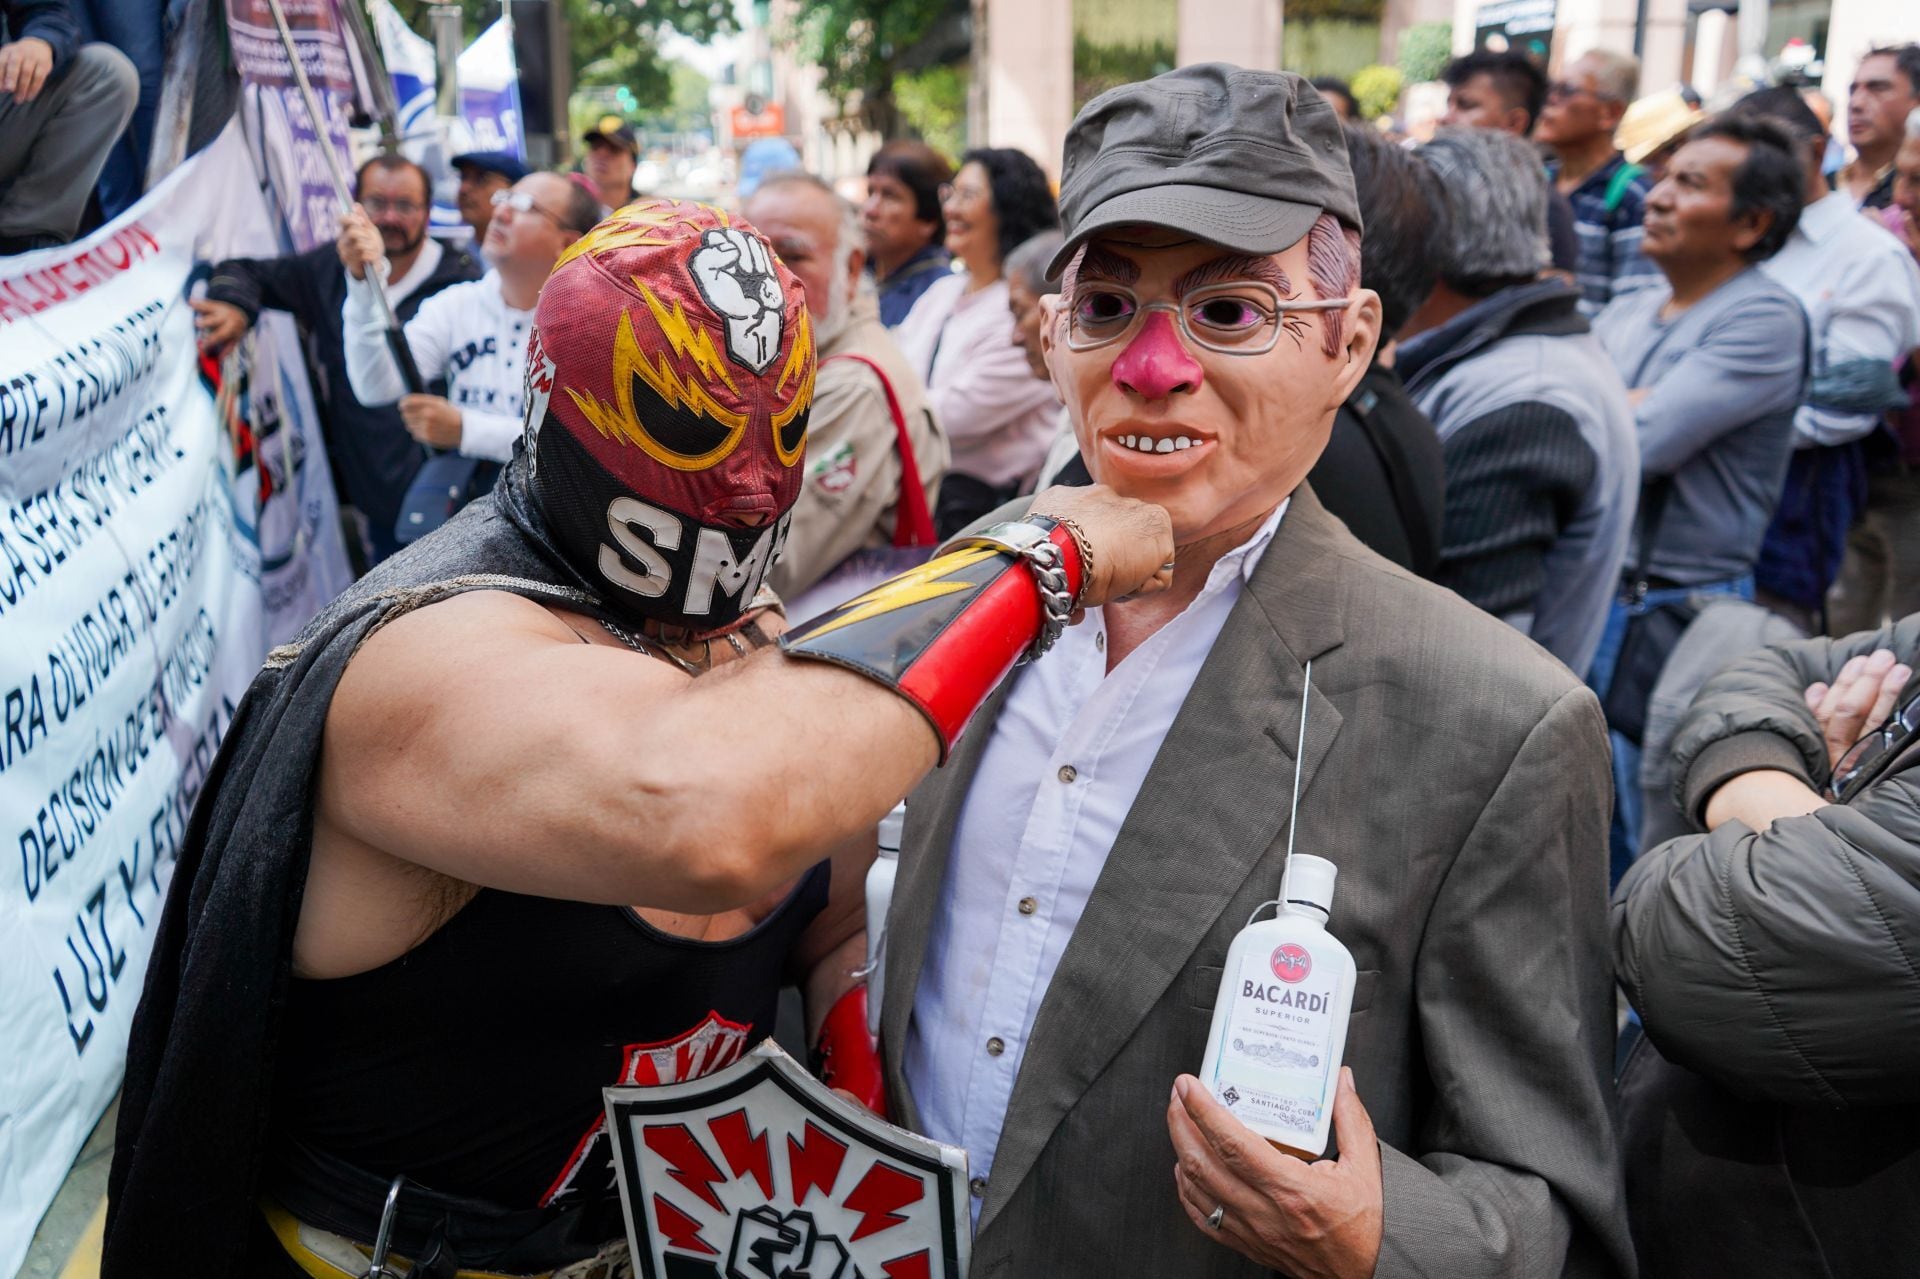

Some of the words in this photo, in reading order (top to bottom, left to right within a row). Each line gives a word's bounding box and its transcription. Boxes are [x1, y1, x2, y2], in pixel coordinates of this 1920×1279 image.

[53, 877, 128, 1057] LUZ
[118, 838, 144, 928] Y
[1242, 979, 1331, 1014] BACARDÍ
[1255, 1007, 1311, 1025] SUPERIOR
[1251, 1097, 1290, 1112] SANTIAGO
[1297, 1107, 1315, 1117] CUBA
